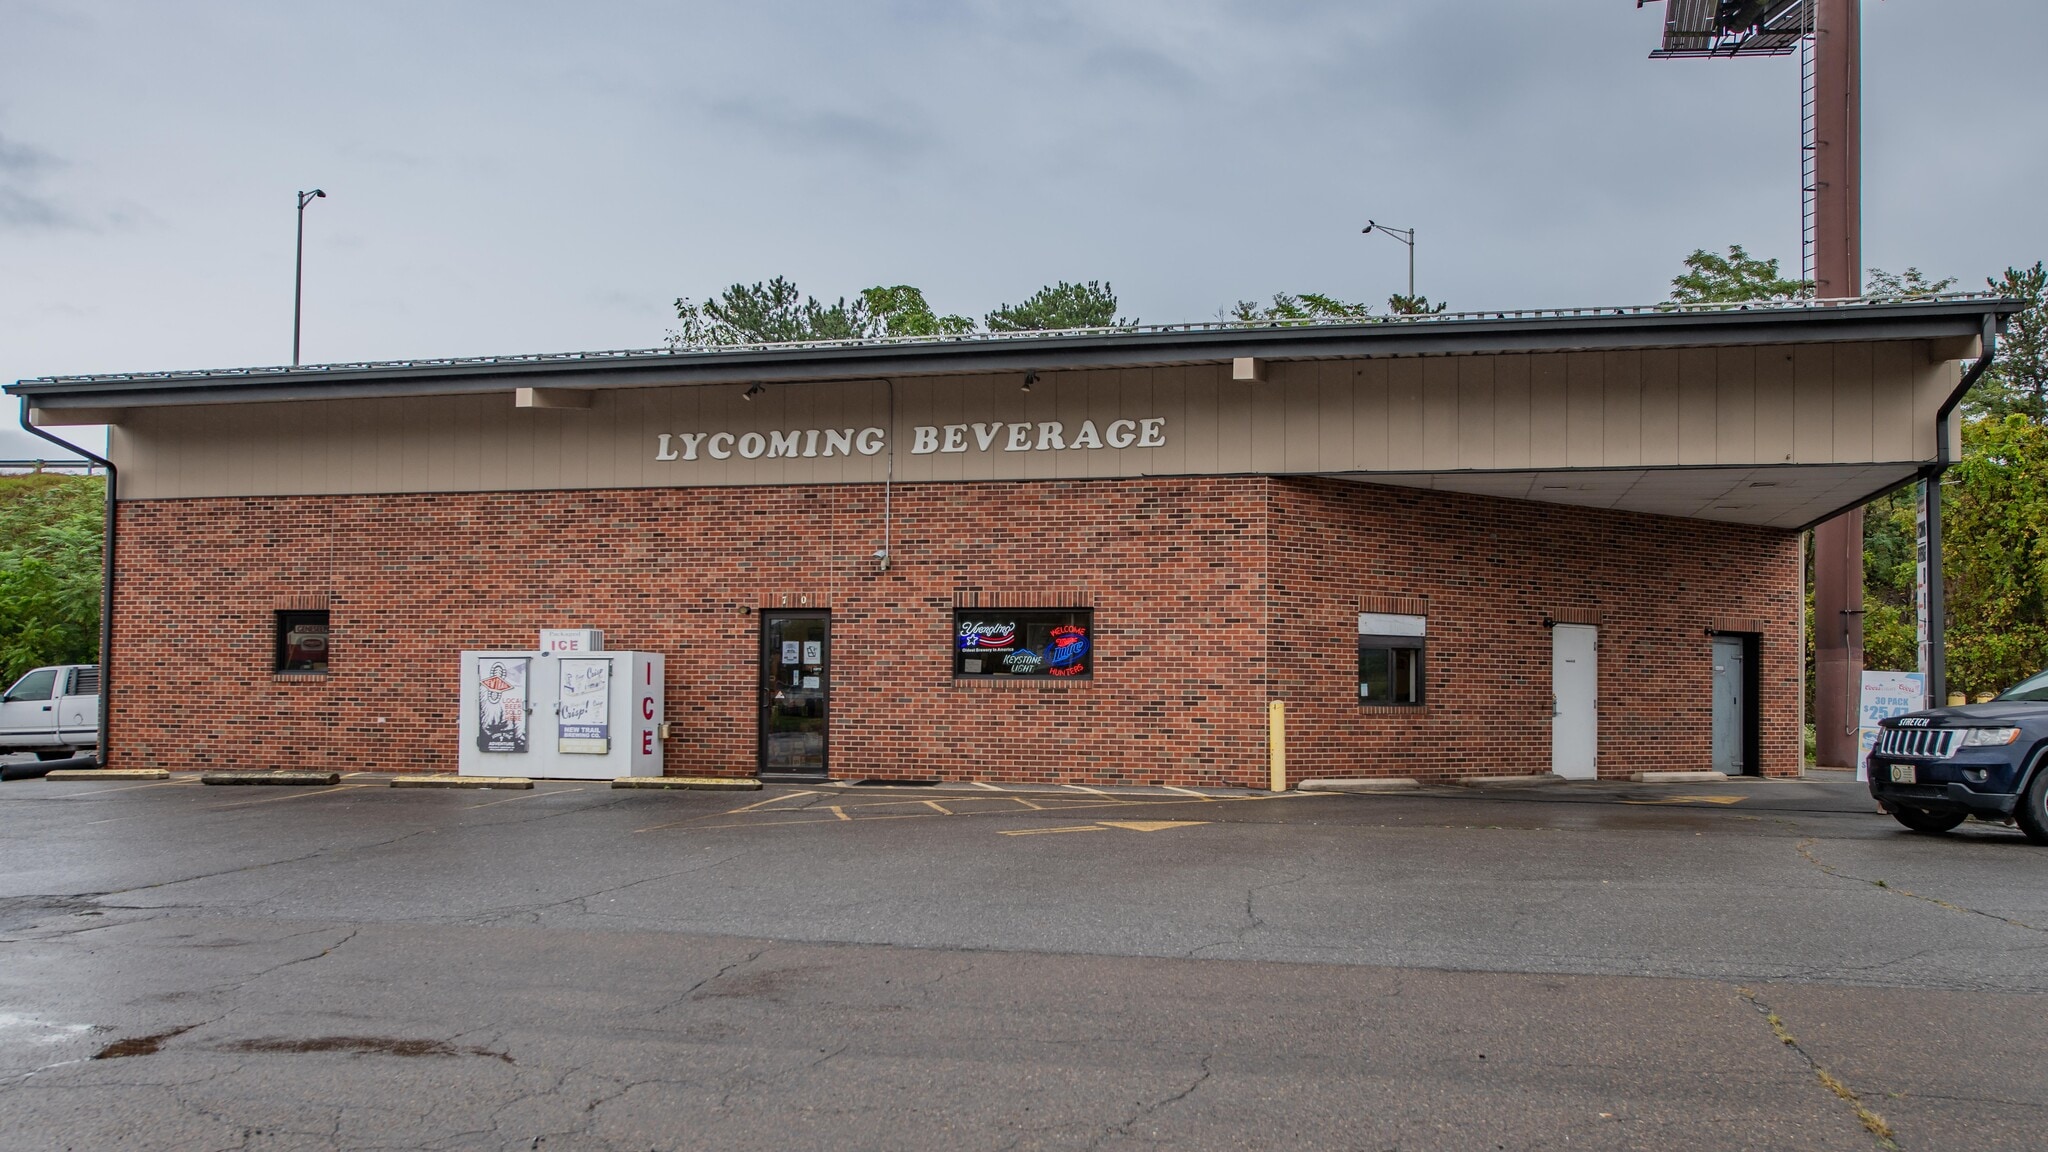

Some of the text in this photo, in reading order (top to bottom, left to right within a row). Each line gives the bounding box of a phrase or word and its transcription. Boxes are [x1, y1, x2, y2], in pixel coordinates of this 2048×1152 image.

[655, 417, 1166, 461] LYCOMING BEVERAGE
[960, 622, 1016, 637] Yuengling
[1050, 625, 1086, 637] WELCOME
[551, 640, 579, 651] ICE
[1003, 655, 1043, 665] KEYSTONE
[1011, 665, 1035, 673] LIGHT
[1049, 664, 1084, 676] HUNTERS
[1875, 696, 1909, 706] 30 PACK
[561, 700, 589, 720] Crisp!
[643, 662, 654, 755] ICE
[1863, 704, 1909, 720] $2547
[1898, 718, 1930, 727] STRETCH
